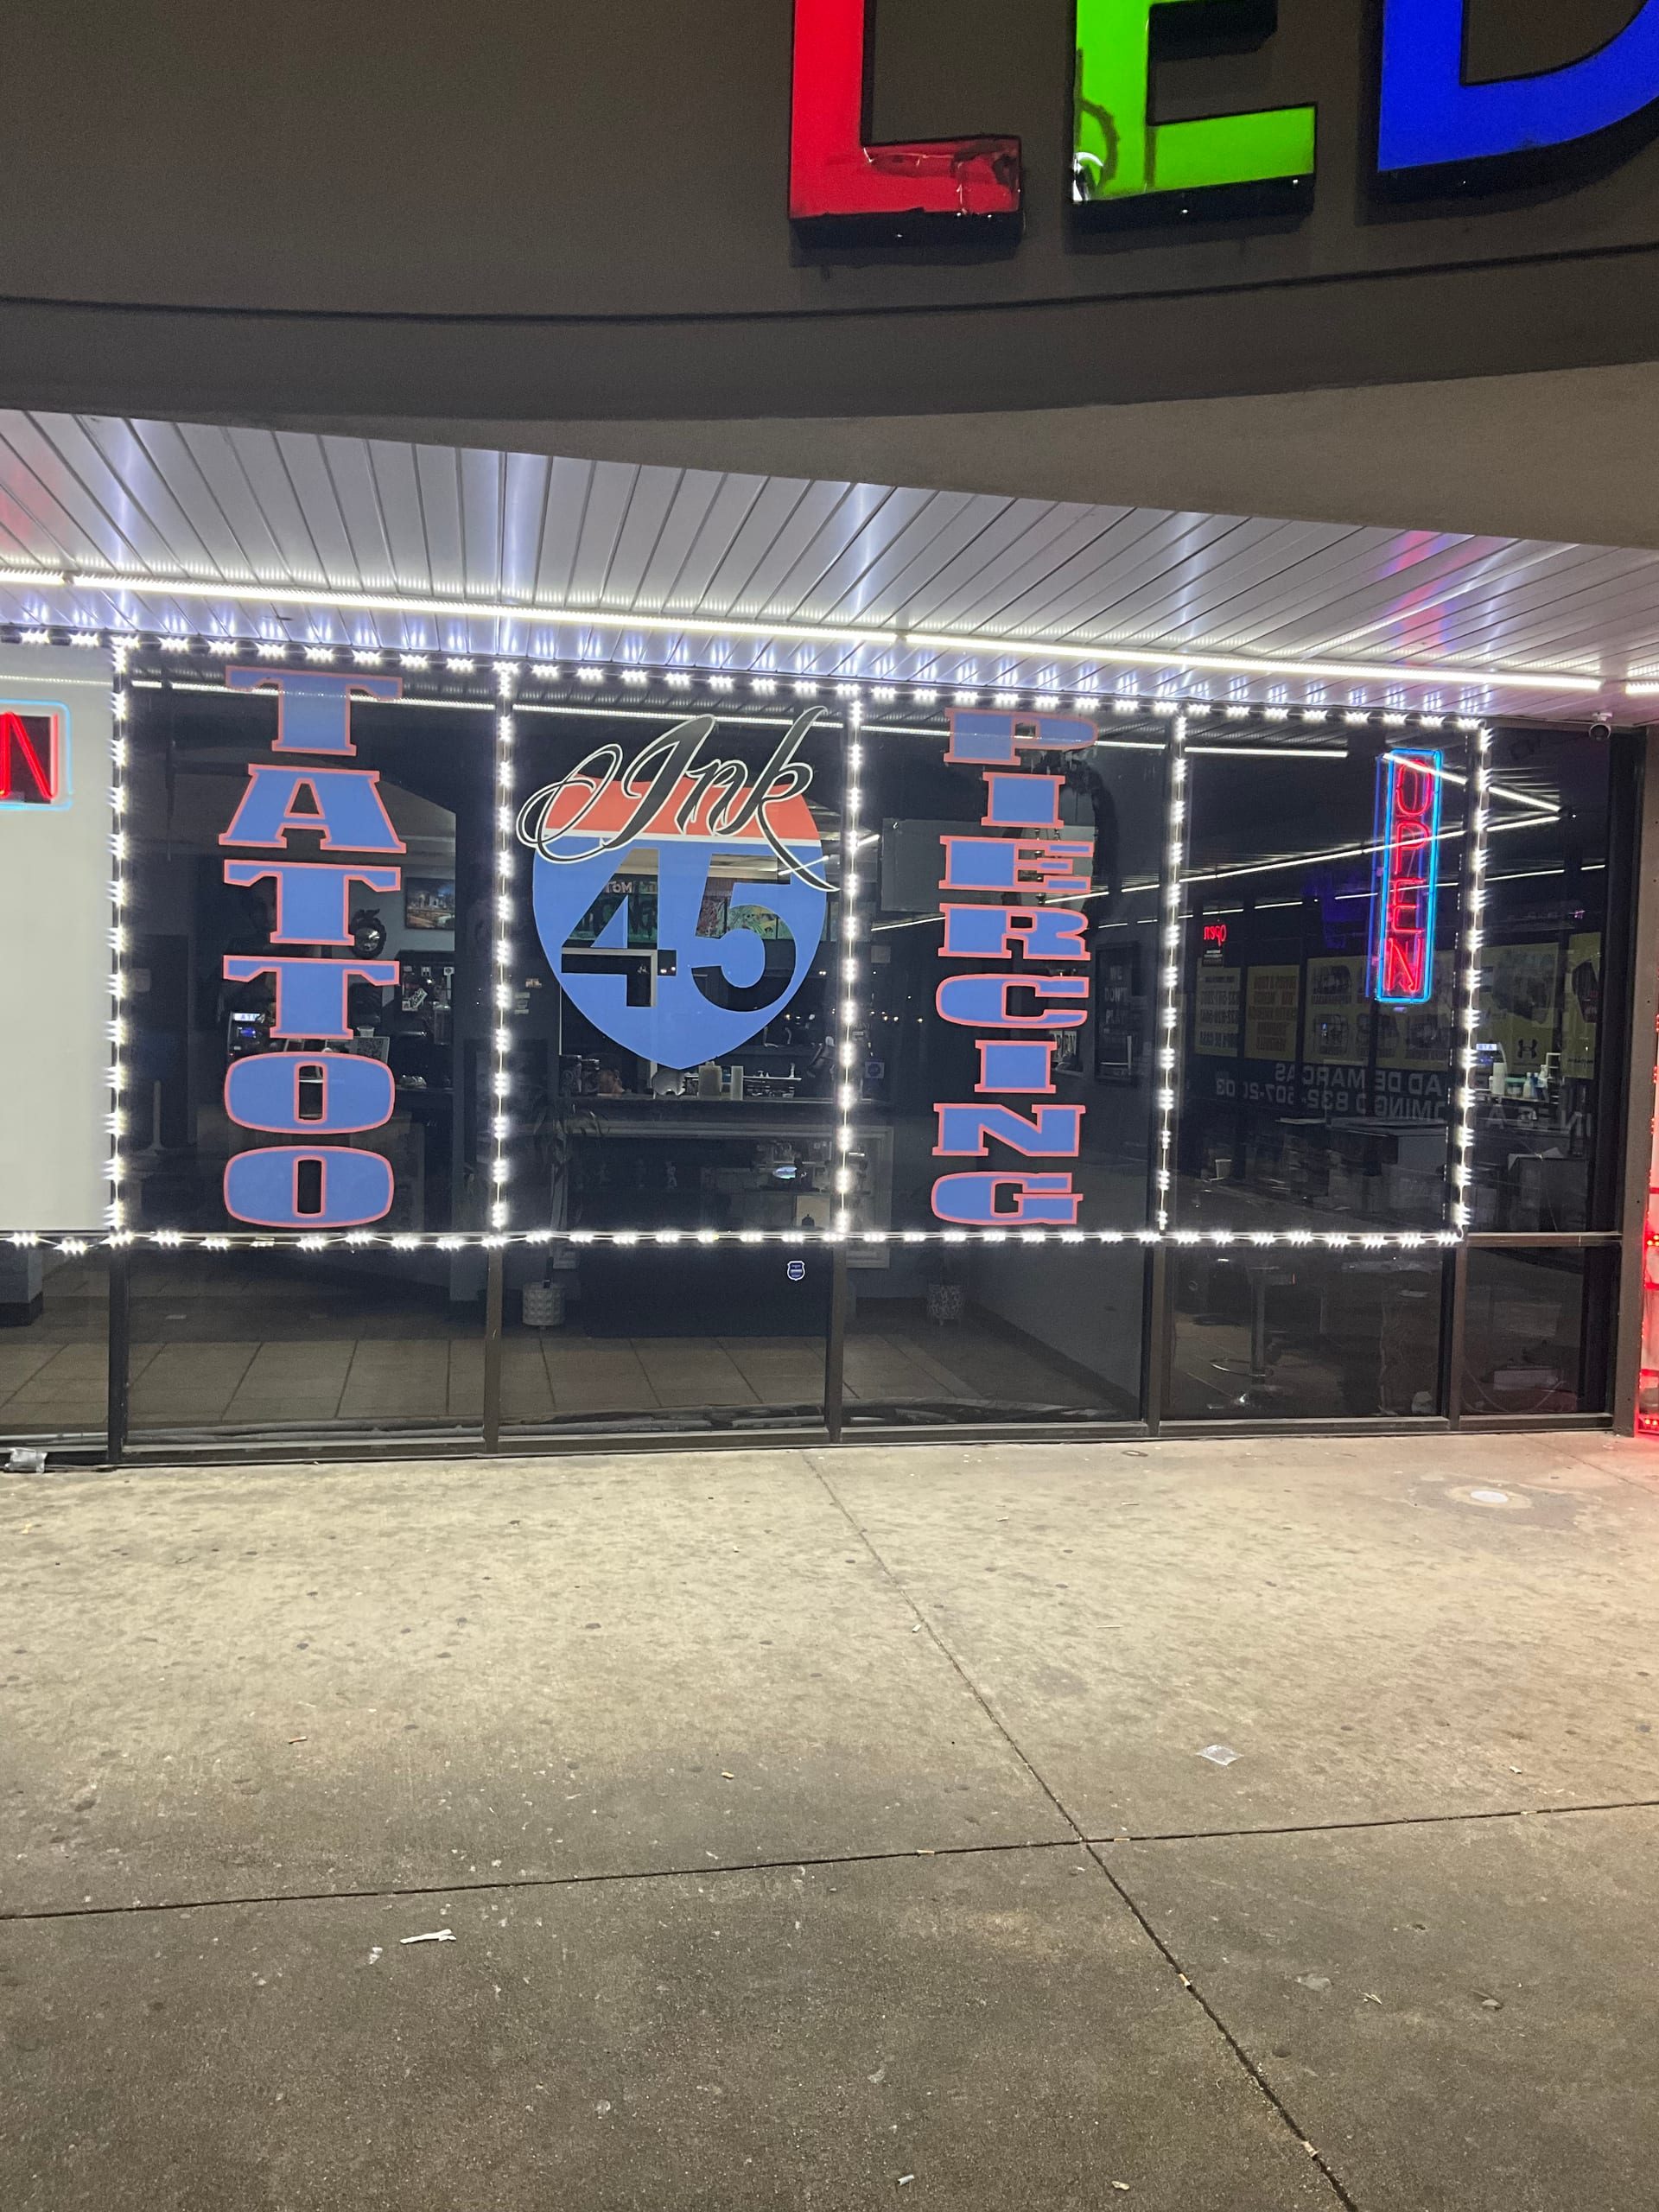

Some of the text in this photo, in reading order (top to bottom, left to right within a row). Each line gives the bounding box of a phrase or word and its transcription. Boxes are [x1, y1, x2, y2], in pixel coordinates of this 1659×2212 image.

[516, 705, 842, 892] Ink
[1384, 759, 1432, 993] OPEN
[219, 664, 406, 1229] TATTOO
[560, 849, 798, 1013] 45
[931, 708, 1098, 1226] PIERCING
